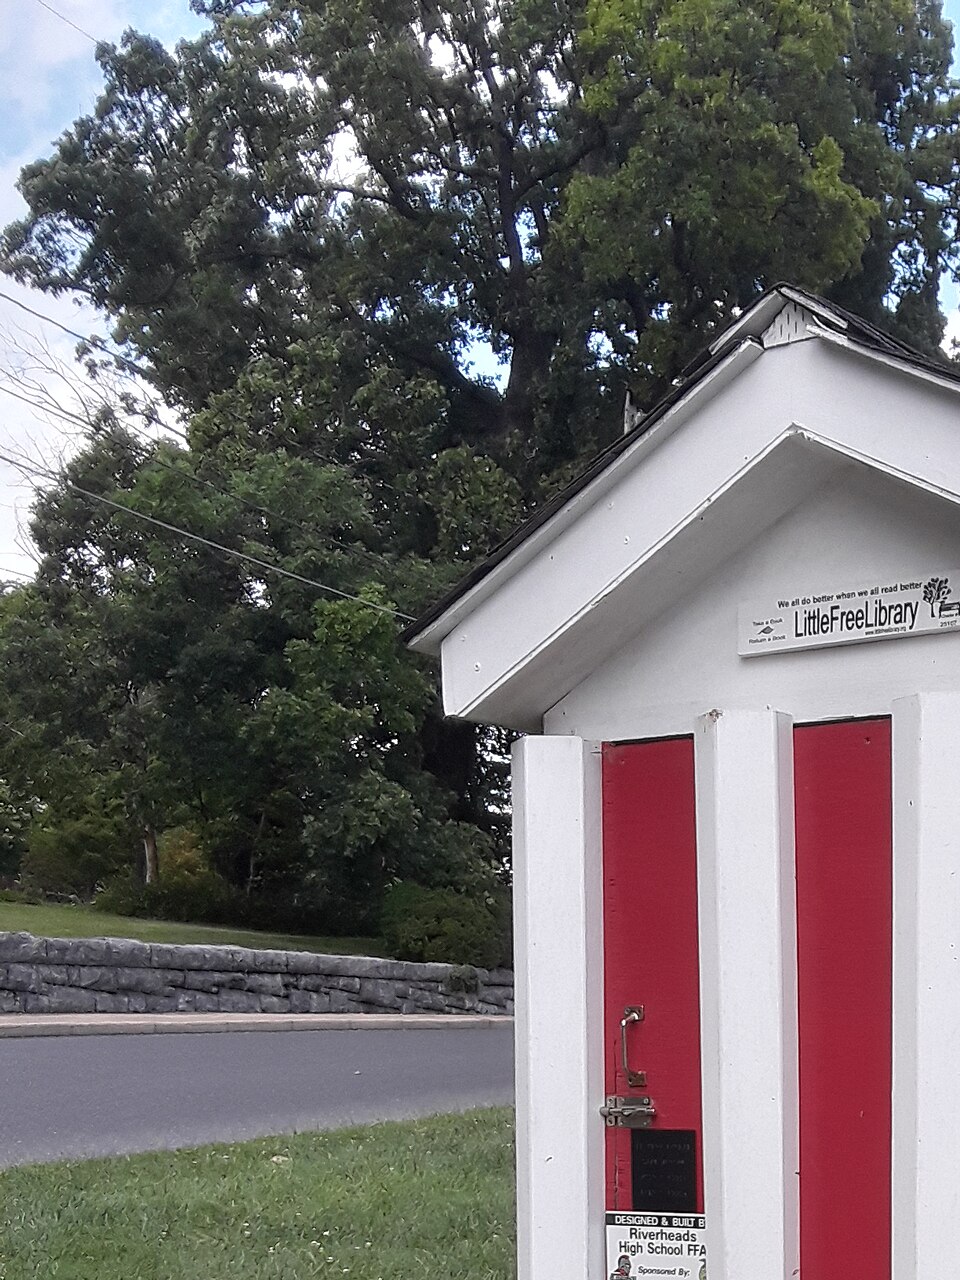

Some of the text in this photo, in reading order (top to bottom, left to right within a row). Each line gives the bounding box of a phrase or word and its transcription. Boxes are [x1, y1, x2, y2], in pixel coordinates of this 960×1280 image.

[791, 599, 800, 607] all
[801, 597, 811, 605] do
[813, 595, 834, 604] better
[836, 591, 856, 600] when
[870, 586, 879, 596] all
[881, 583, 898, 594] read
[900, 582, 922, 591] better
[795, 599, 919, 637] LittleFreeLibrary
[615, 1215, 658, 1225] DESIGNED
[661, 1217, 669, 1226] &
[672, 1217, 695, 1227] BUILT
[630, 1228, 697, 1242] Riverheads
[619, 1241, 706, 1256] High School FFA
[638, 1266, 690, 1277] Sponsored By:
